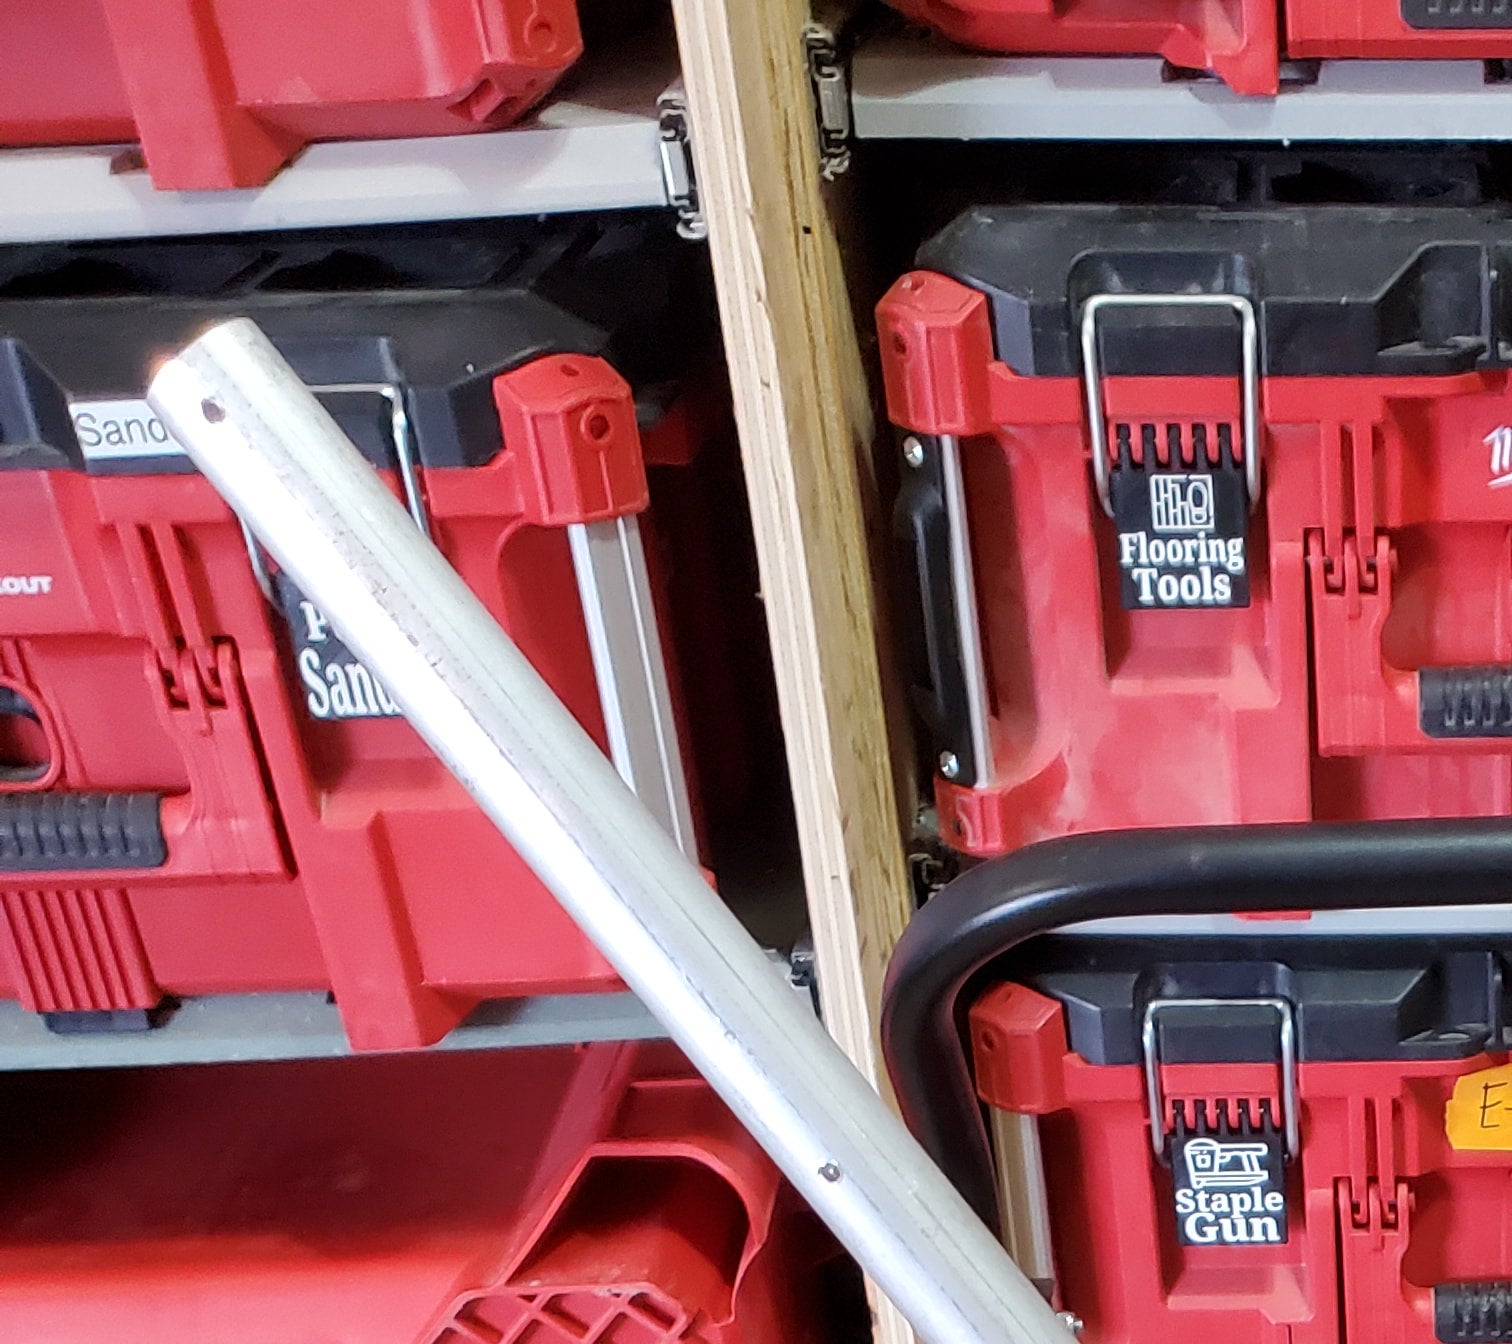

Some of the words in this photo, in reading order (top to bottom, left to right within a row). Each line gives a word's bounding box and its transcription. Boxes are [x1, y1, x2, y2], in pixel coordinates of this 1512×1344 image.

[1118, 531, 1245, 575] Flooring
[1131, 565, 1232, 606] Tools
[1175, 1186, 1284, 1219] Staple
[1184, 1212, 1281, 1243] Gun
